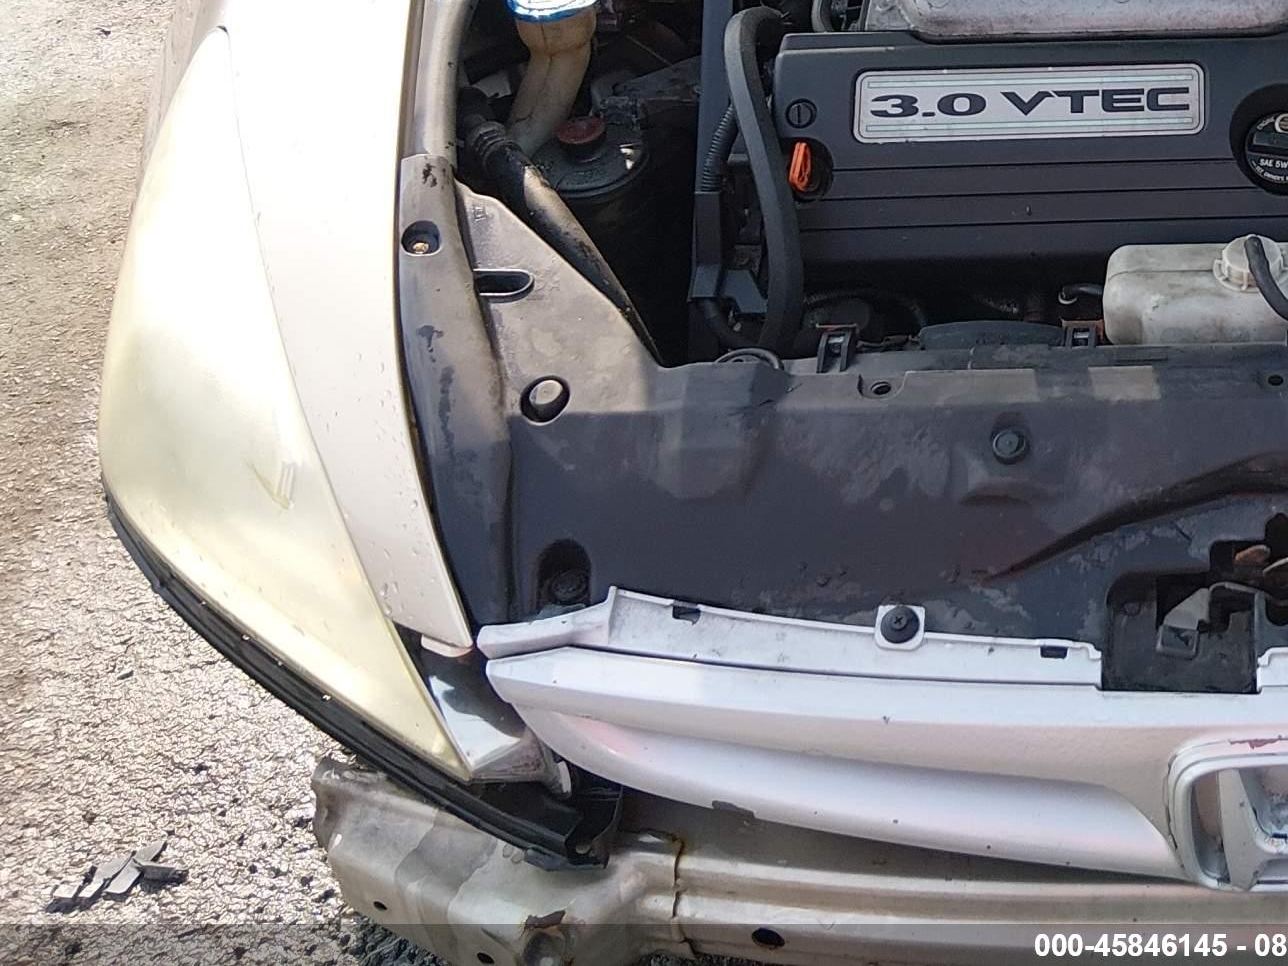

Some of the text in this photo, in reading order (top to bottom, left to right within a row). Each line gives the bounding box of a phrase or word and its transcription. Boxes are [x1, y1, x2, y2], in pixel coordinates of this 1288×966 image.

[870, 87, 1190, 118] 3.0 VTEC
[1259, 158, 1273, 167] SAE
